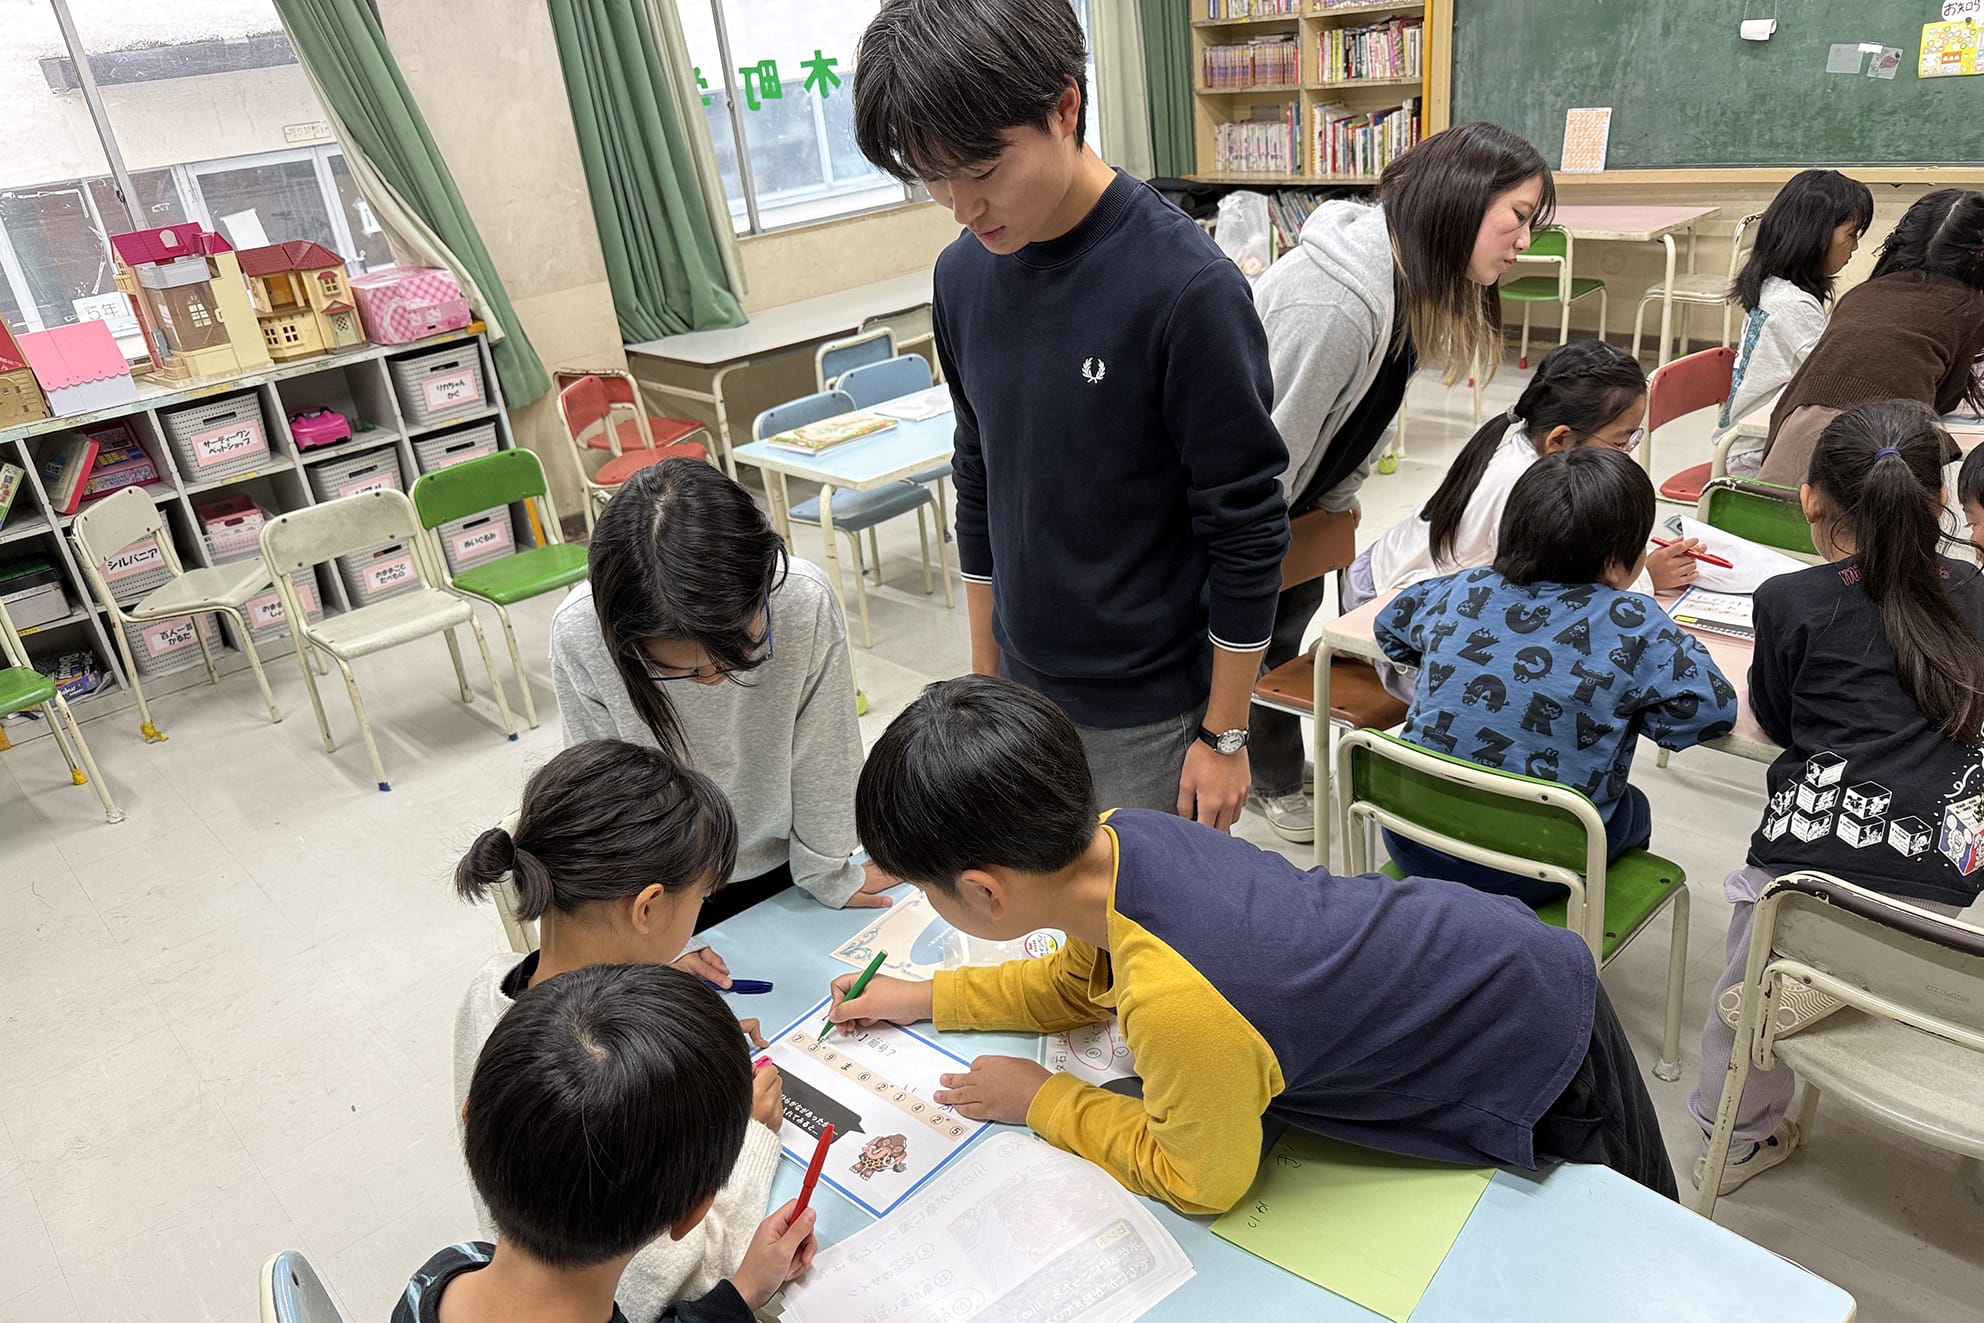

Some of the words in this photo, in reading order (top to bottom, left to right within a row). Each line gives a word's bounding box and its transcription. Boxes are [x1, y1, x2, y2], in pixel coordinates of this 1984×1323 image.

[209, 437, 250, 454] ペットショップ
[464, 532, 496, 548] ぬいぐるみ
[107, 547, 158, 570] シルバニア
[376, 563, 406, 578] おままごと
[160, 623, 193, 640] 百人一首
[168, 632, 192, 645] かるた
